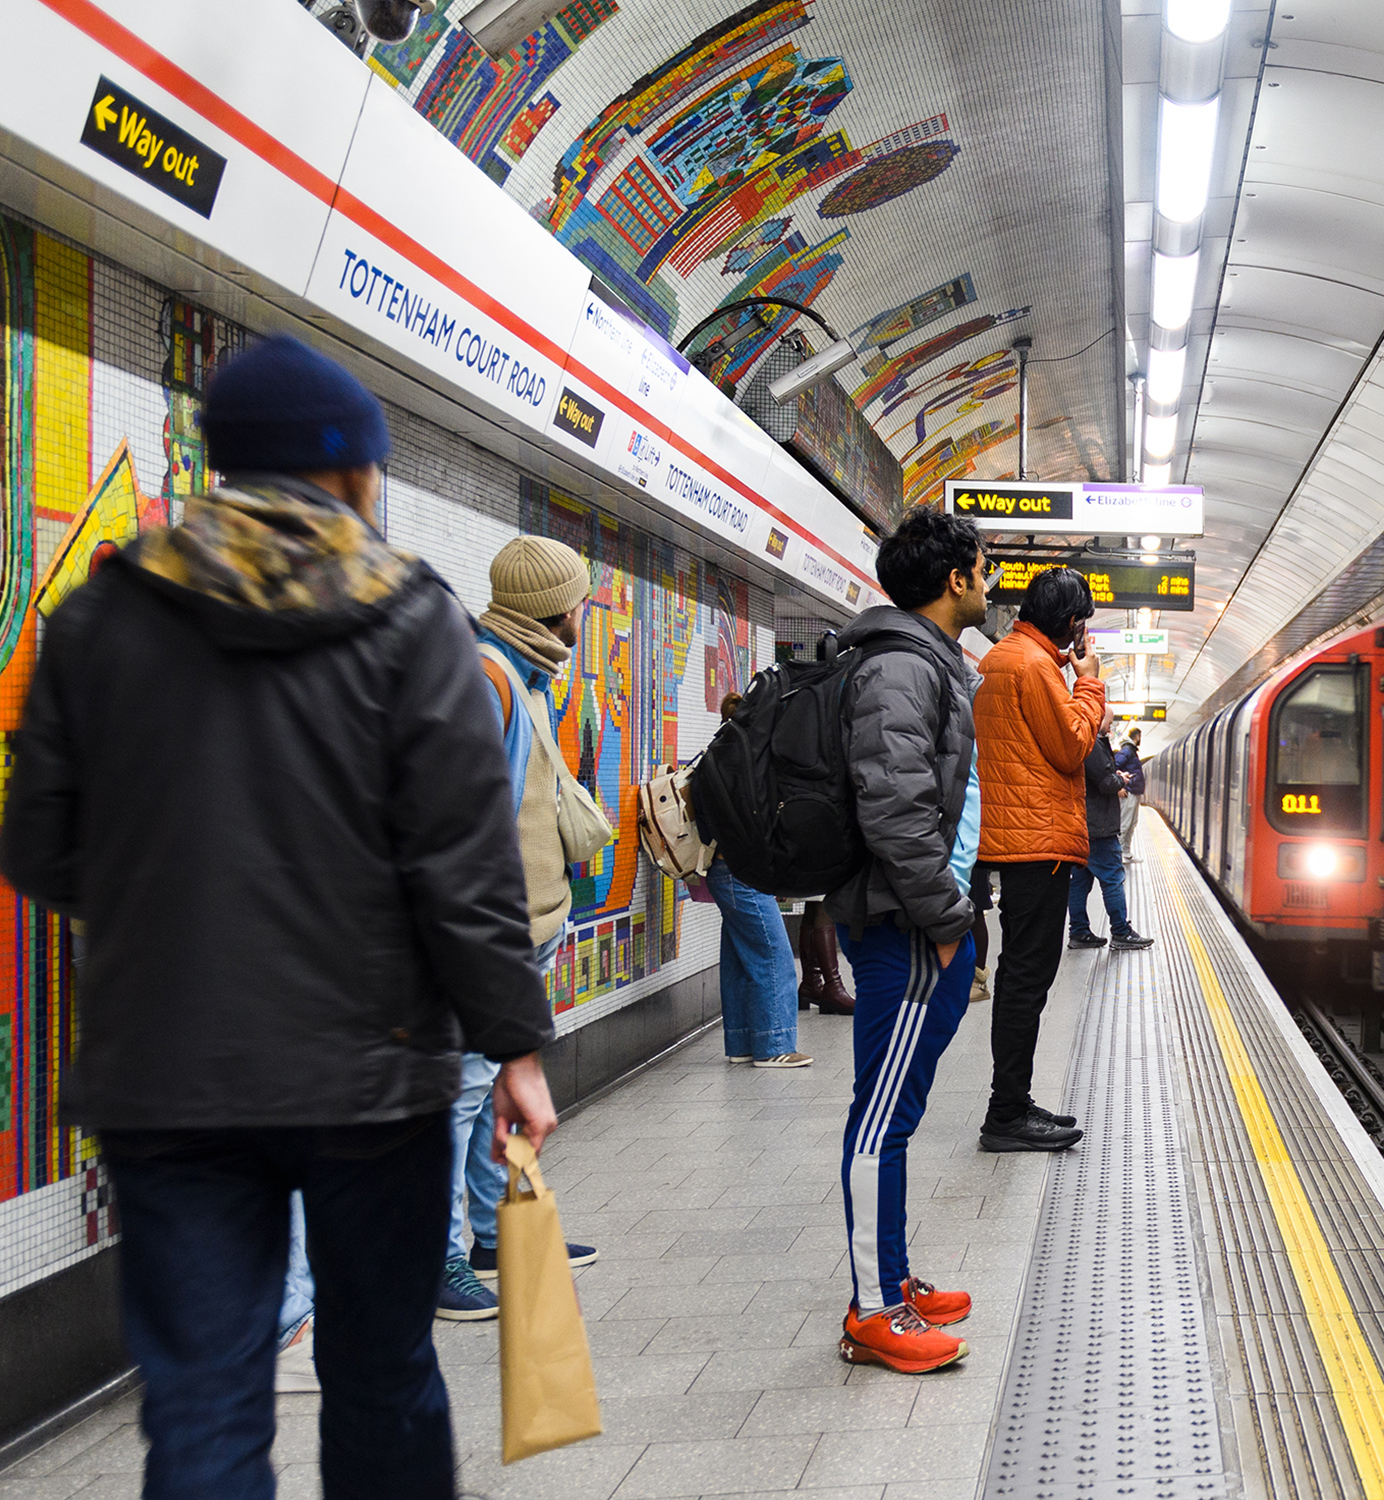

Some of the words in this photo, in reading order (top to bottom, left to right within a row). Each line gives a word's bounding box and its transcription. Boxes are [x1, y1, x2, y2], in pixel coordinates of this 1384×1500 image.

[118, 105, 164, 169] Way
[162, 146, 199, 187] out
[339, 248, 456, 353] TOTTENHAM
[455, 327, 510, 384] COURT
[506, 360, 546, 407] ROAD
[566, 399, 583, 429] Way
[580, 413, 595, 433] out
[665, 463, 711, 510] TOTTENHAM
[709, 492, 733, 524] COURT
[729, 506, 748, 533] ROAD
[977, 493, 1016, 514] Way
[1019, 496, 1051, 512] out
[1000, 561, 1025, 571] South
[1089, 573, 1110, 583] Park
[1161, 575, 1169, 585] 2
[1170, 576, 1189, 585] mins
[1089, 582, 1110, 592] Park
[1157, 584, 1168, 594] 10
[1170, 585, 1189, 594] mins
[1282, 794, 1321, 814] 011
